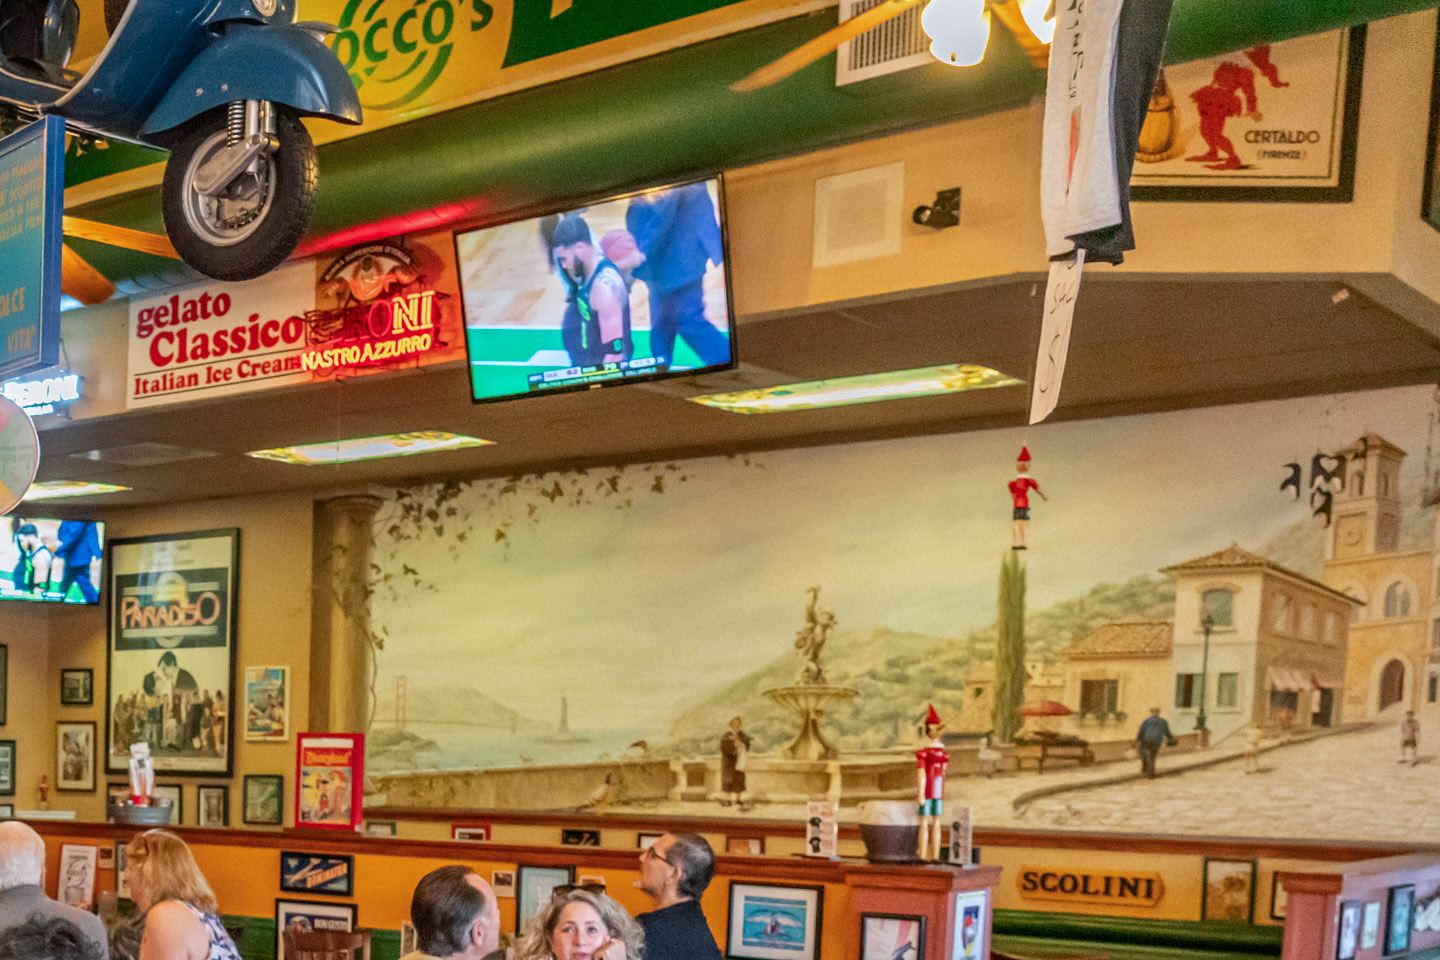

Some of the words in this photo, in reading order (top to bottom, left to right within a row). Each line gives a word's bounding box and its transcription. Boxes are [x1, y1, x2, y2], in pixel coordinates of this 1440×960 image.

[1244, 130, 1320, 144] CERTALDO
[136, 291, 231, 339] gelato
[149, 312, 304, 367] Classico
[300, 342, 361, 371] NASTRO
[360, 333, 432, 363] AZZURRO
[133, 368, 199, 396] Italian
[204, 365, 233, 385] Ice
[237, 352, 302, 381] Cream
[121, 591, 220, 629] PARADISO
[1022, 871, 1155, 899] SCOLINI
